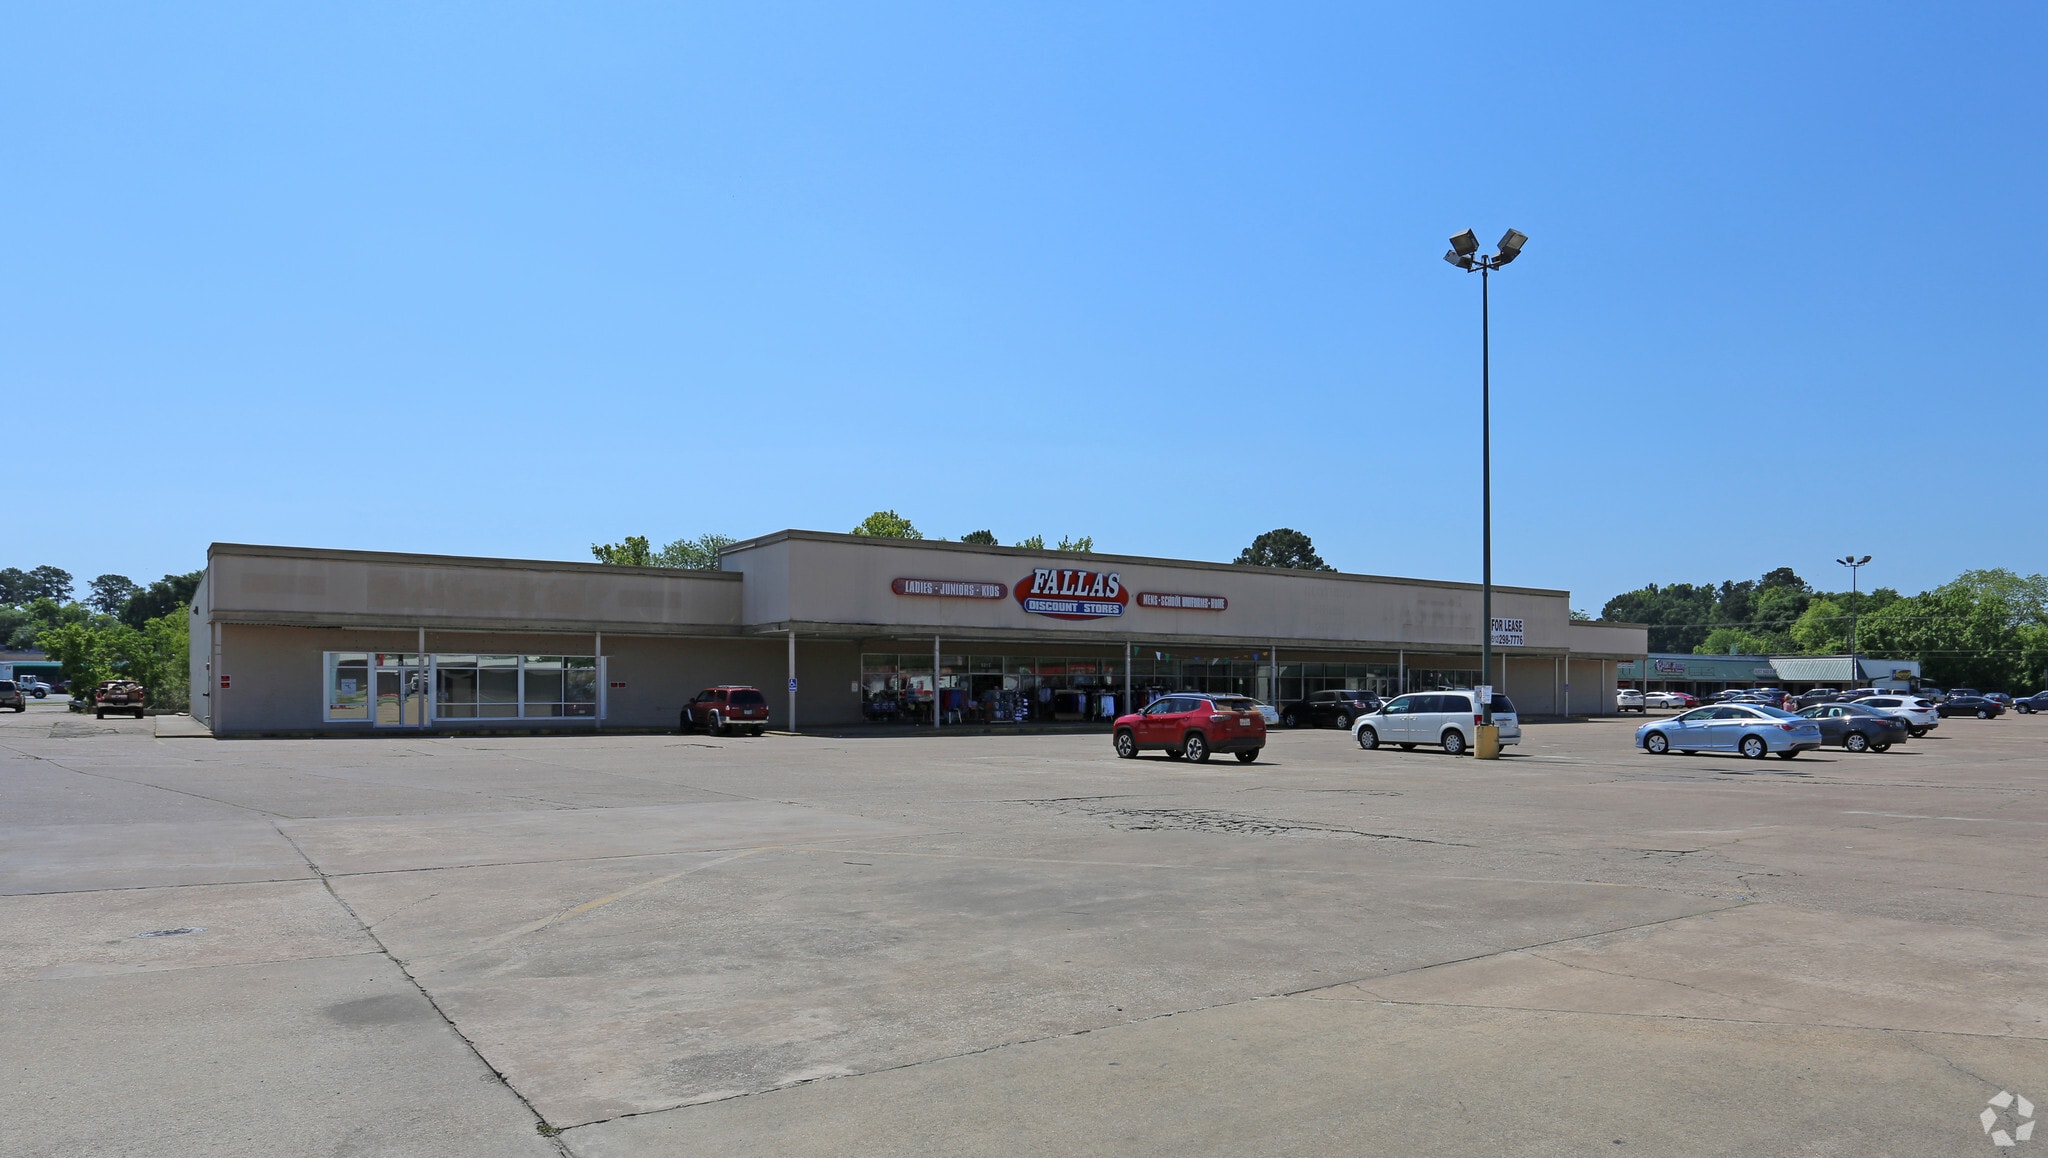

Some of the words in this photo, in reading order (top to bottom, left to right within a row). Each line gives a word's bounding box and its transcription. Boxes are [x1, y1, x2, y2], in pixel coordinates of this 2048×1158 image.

[905, 580, 932, 594] LADIES
[940, 583, 974, 596] JUNIORS
[981, 585, 1000, 597] KIDS
[1030, 569, 1120, 598] FALLAS
[1143, 594, 1158, 606] MENS
[1029, 601, 1078, 612] DISCOUNT
[1084, 604, 1120, 614] STORES
[1491, 618, 1503, 632] FOR
[1504, 619, 1523, 632] LEASE
